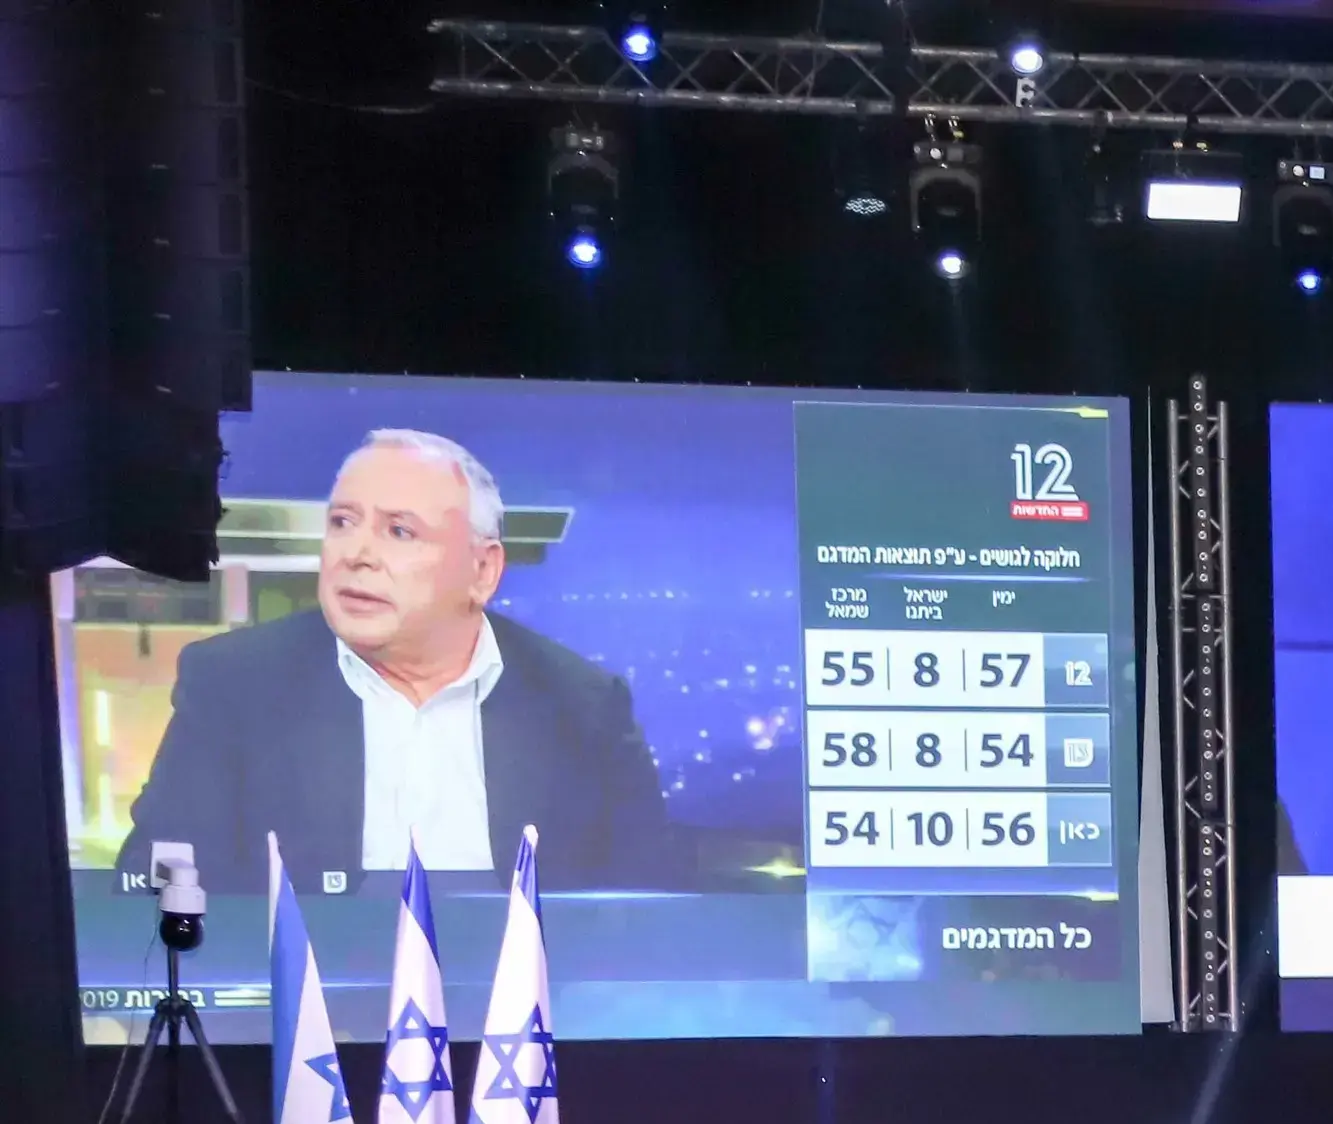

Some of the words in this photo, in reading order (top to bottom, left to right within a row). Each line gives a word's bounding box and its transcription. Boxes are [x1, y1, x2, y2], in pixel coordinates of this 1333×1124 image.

[1011, 443, 1079, 501] 12
[1012, 504, 1059, 517] החדשות
[816, 545, 871, 564] המדגם
[874, 545, 931, 565] תוצאות
[979, 545, 1031, 567] לגושים
[1033, 546, 1080, 572] חלוקה
[831, 586, 868, 602] מרכז
[903, 586, 948, 604] ישראל
[991, 589, 1016, 608] ימין
[825, 601, 869, 619] שמאל
[905, 605, 943, 620] ביתנו
[821, 650, 875, 687] 55
[912, 651, 941, 689] 8
[979, 652, 1031, 689] 57
[1064, 660, 1093, 687] 12
[822, 732, 878, 768] 58
[915, 732, 942, 769] 8
[979, 733, 1034, 769] 54
[824, 811, 880, 846] 54
[906, 811, 953, 847] 10
[981, 811, 1036, 847] 56
[1059, 820, 1100, 845] כאן
[122, 872, 146, 891] אן
[942, 925, 1054, 950] המדגמים
[1059, 922, 1092, 949] כל
[82, 989, 119, 1009] 019
